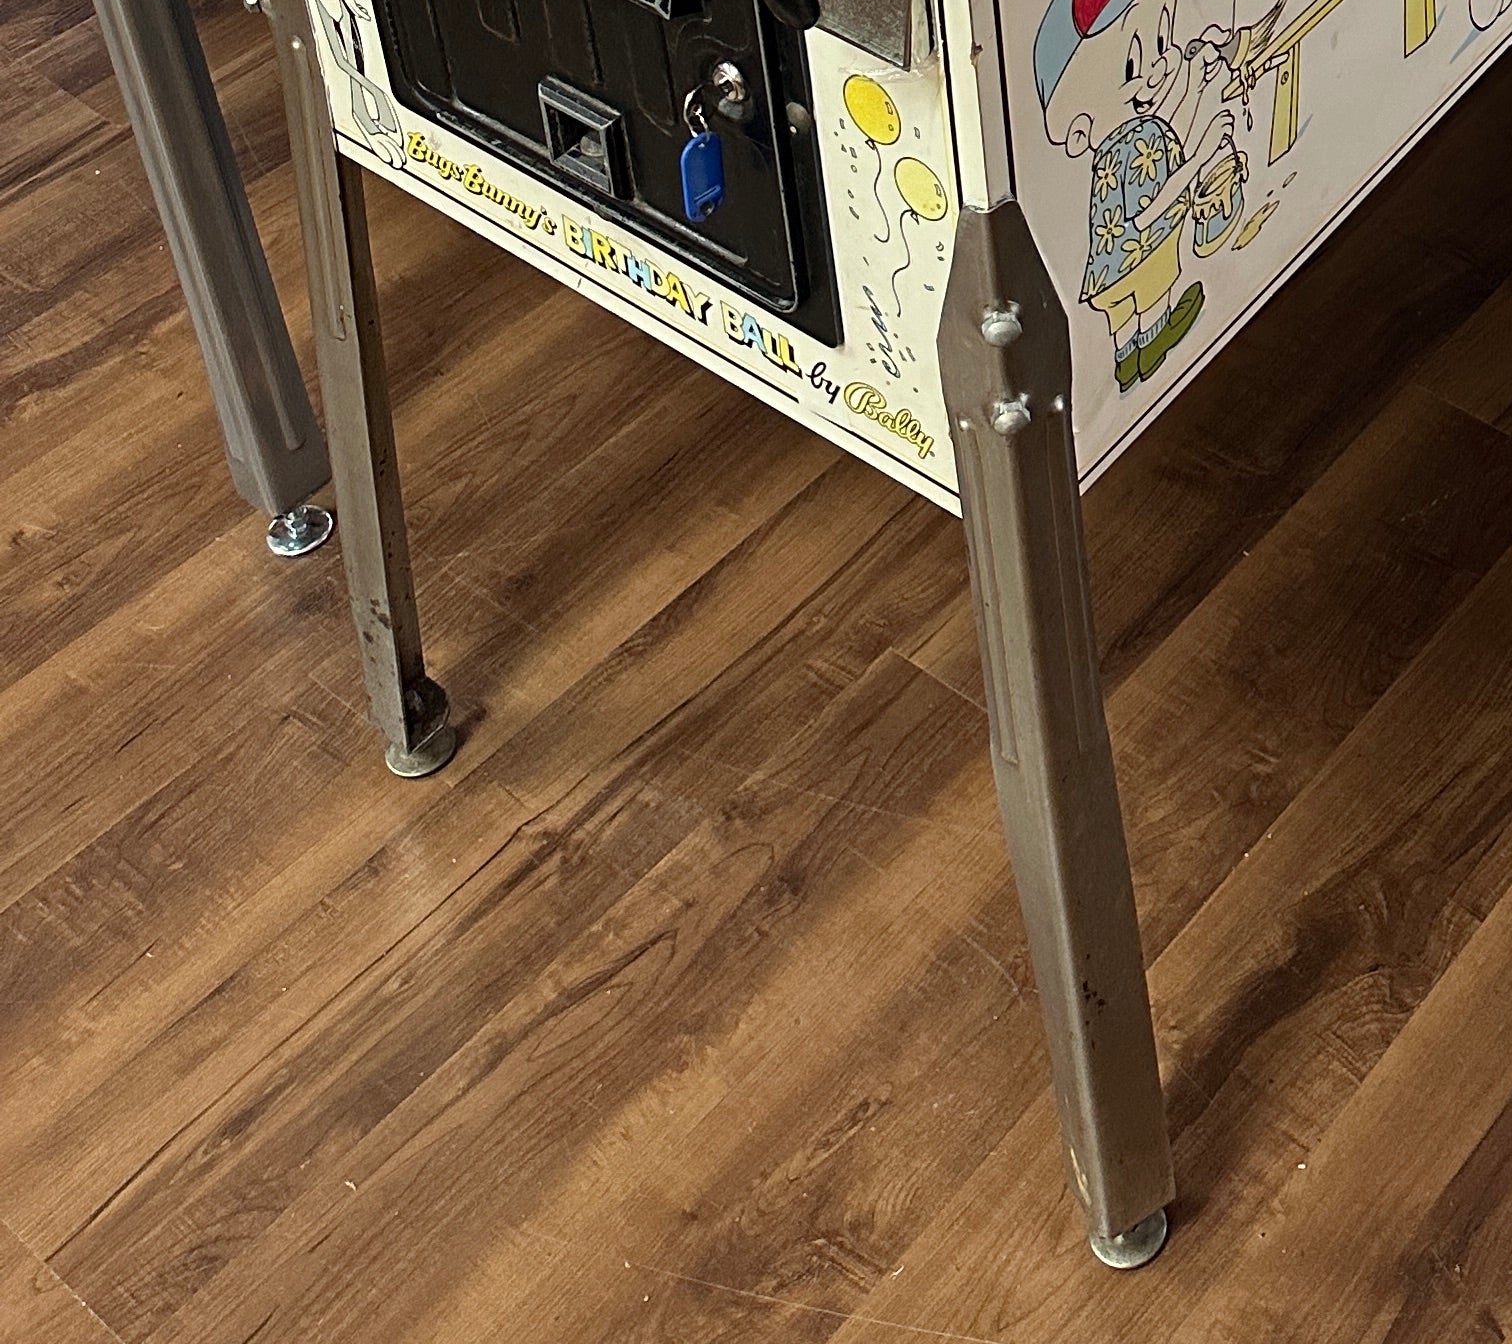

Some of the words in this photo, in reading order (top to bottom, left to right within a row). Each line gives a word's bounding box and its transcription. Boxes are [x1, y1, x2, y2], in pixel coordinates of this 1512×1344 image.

[406, 131, 466, 181] Bugs
[463, 164, 557, 237] Bunny's
[561, 212, 712, 325] BIRTHDAY
[720, 299, 802, 376] BALL
[805, 361, 842, 403] by
[844, 381, 935, 459] Bally
